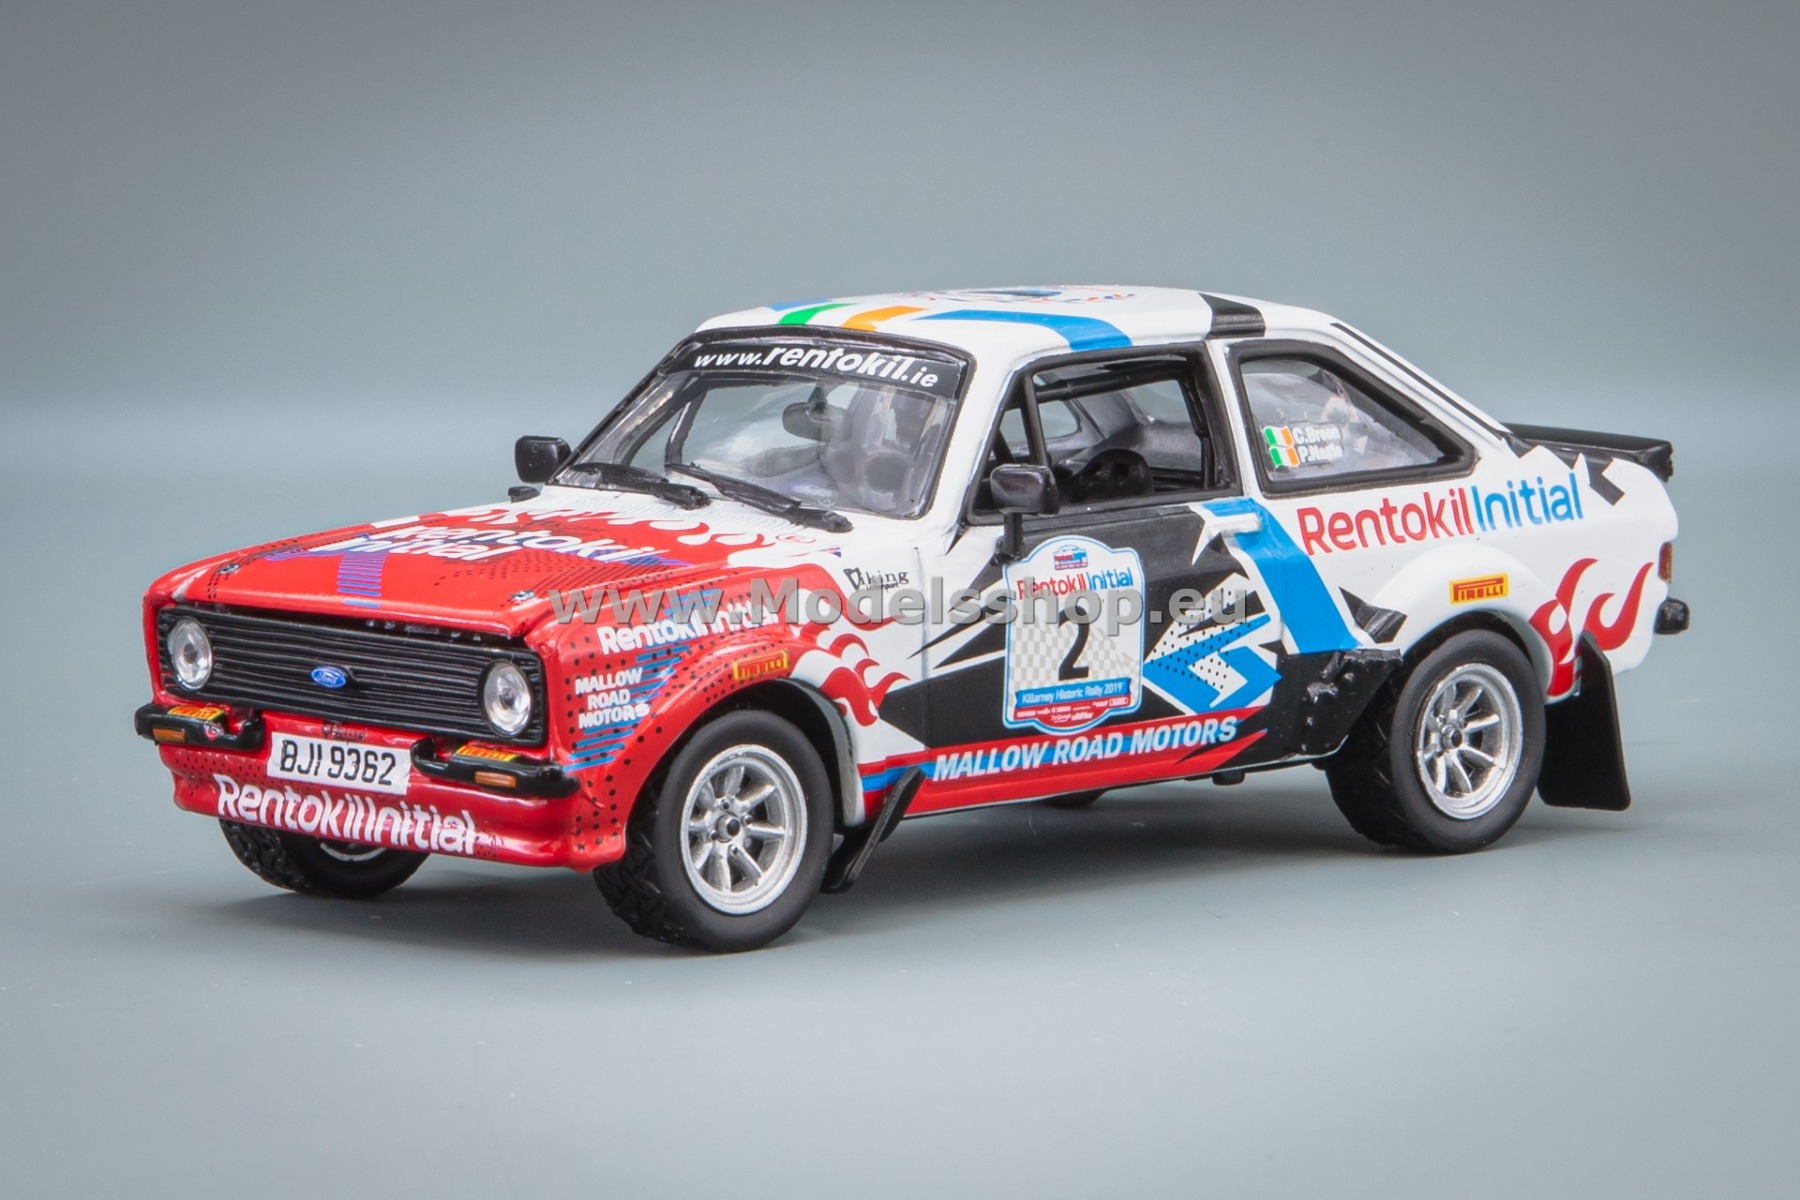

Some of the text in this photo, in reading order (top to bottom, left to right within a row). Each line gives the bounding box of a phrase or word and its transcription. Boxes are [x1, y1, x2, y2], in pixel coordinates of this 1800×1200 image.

[693, 346, 938, 388] www.rentokil.ie
[1453, 576, 1504, 601] PIRELLI
[1057, 605, 1090, 681] 2
[575, 667, 643, 695] MALLOW
[578, 702, 650, 729] MOTORS
[587, 689, 631, 710] ROAD
[327, 745, 397, 786] 9362
[932, 716, 1237, 782] MALLOW ROAD MOTORS
